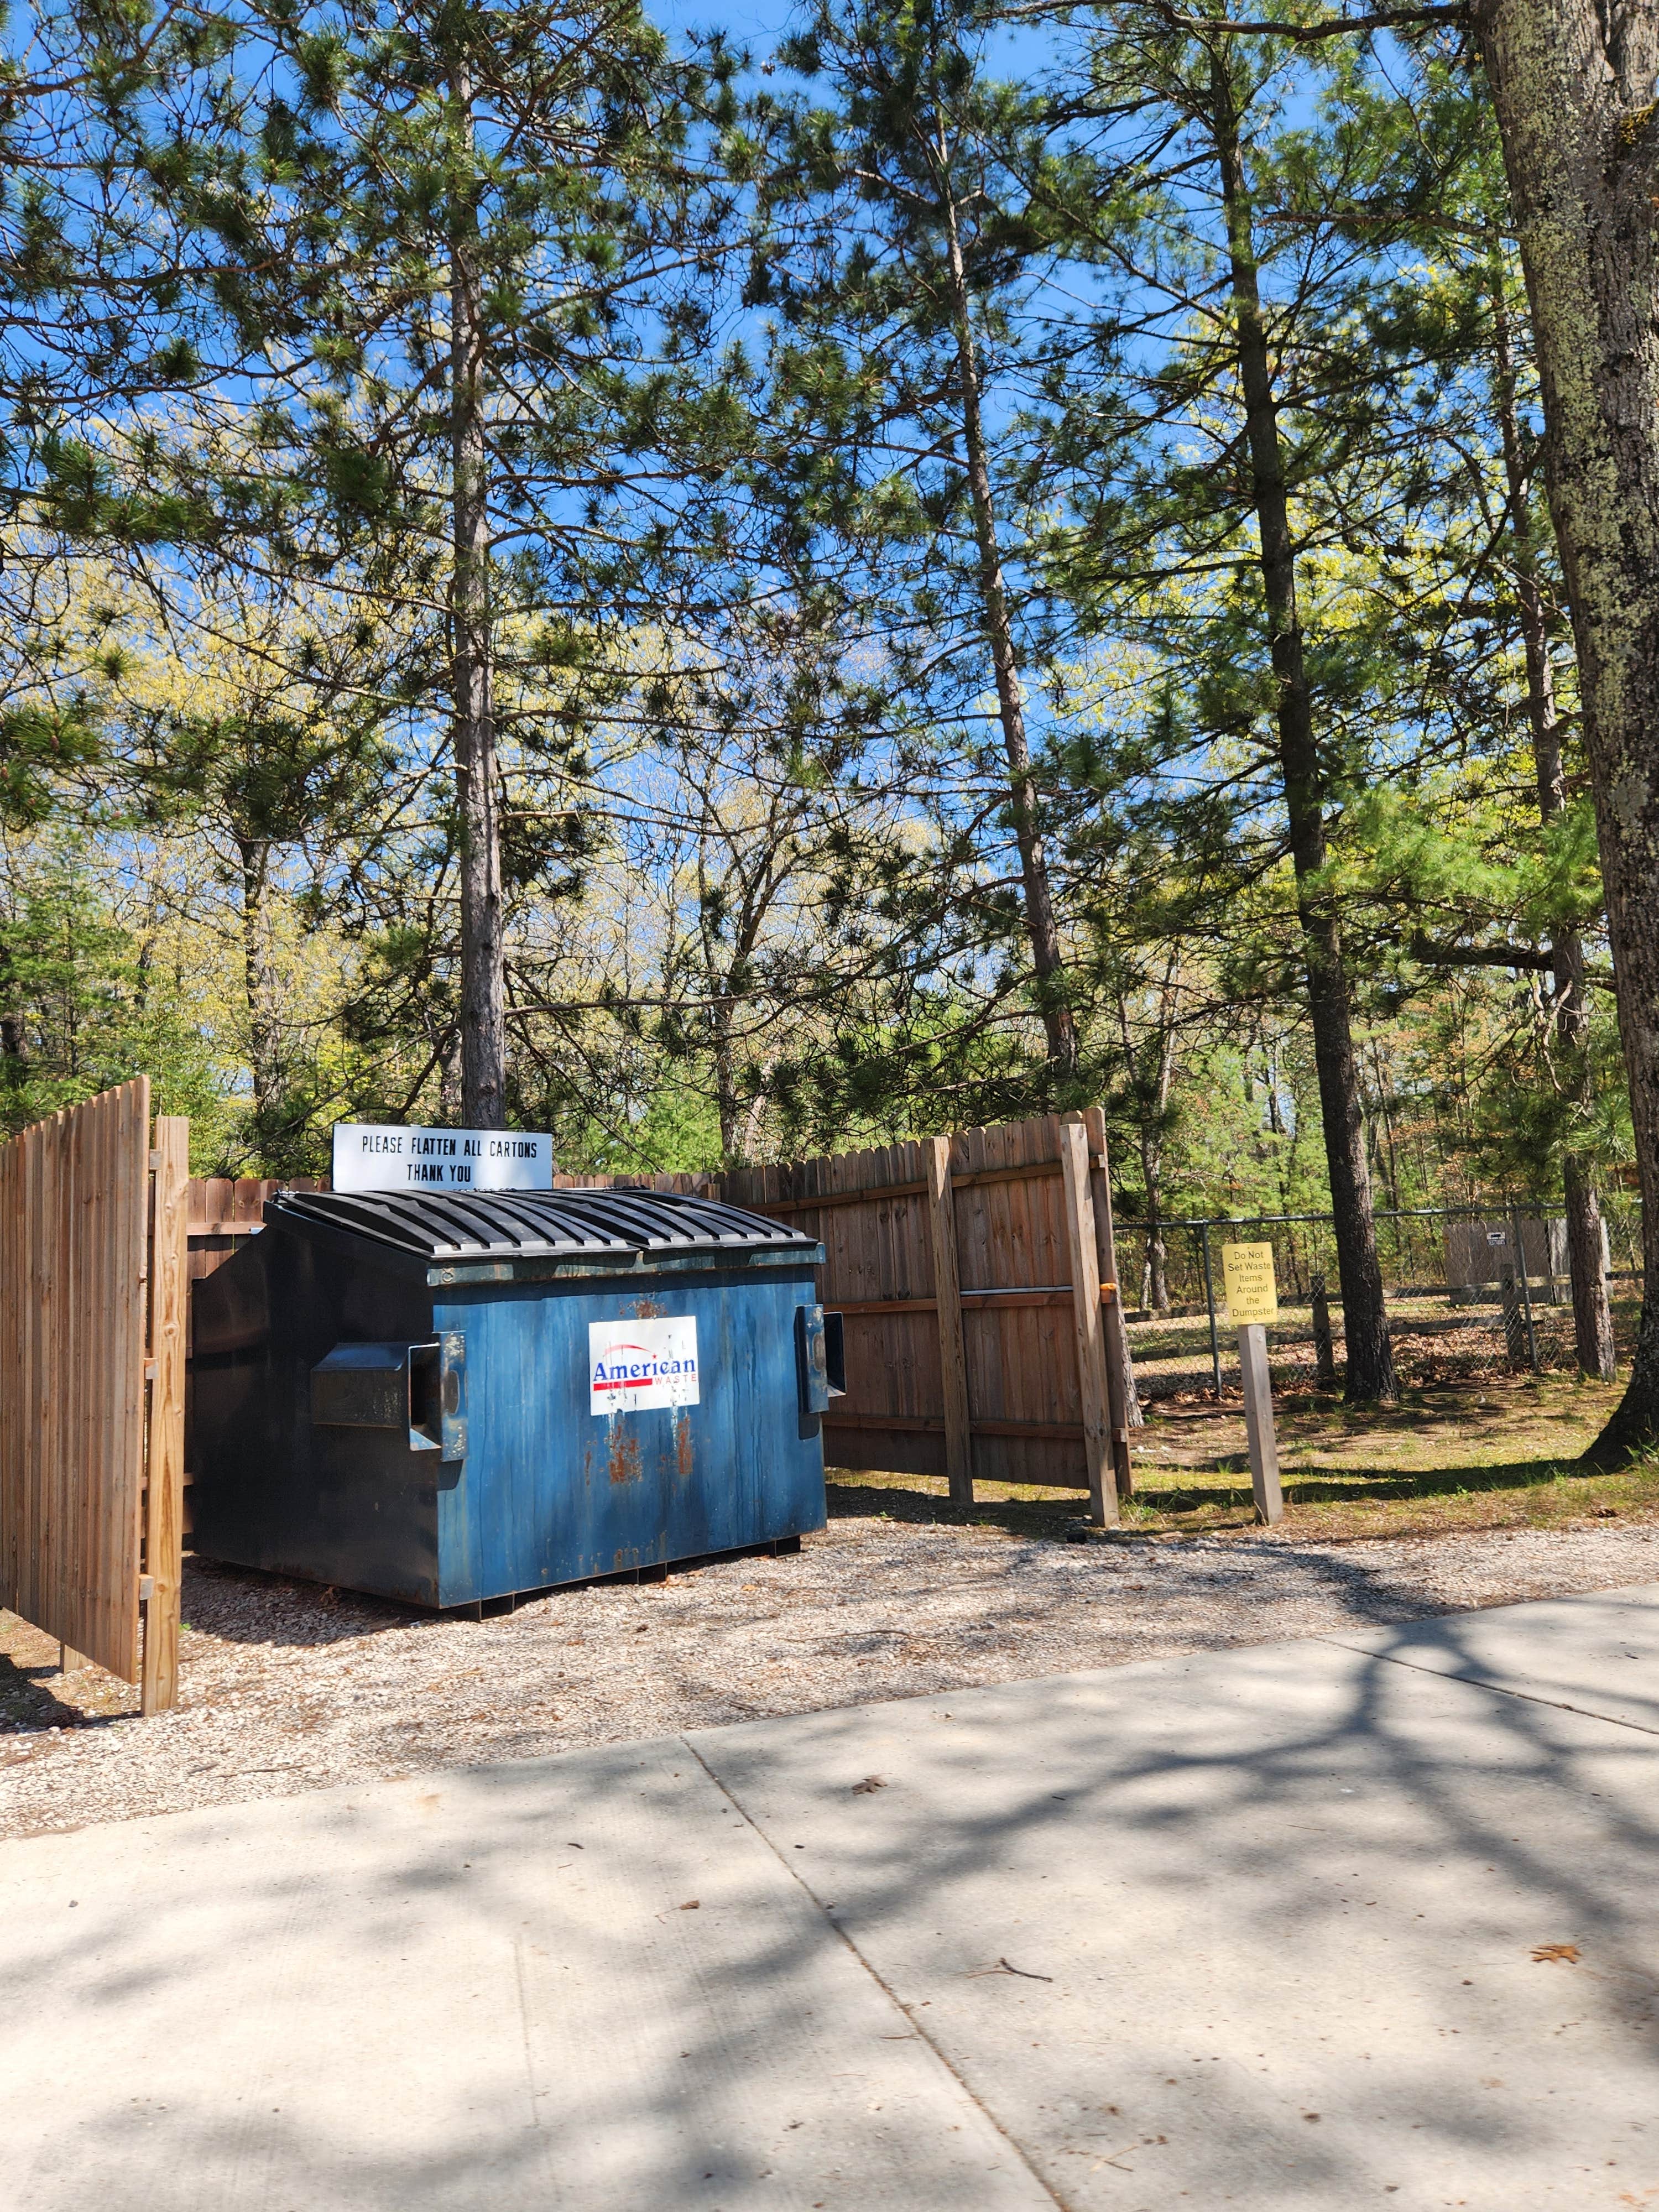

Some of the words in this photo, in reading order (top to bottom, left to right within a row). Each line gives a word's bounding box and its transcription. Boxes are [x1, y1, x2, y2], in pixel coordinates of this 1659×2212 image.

[362, 1135, 403, 1154] PLEASE
[411, 1138, 456, 1156] FLATTEN
[463, 1139, 482, 1157] ALL
[490, 1141, 537, 1159] CARTONS
[408, 1164, 443, 1182] THANK
[450, 1165, 471, 1182] YOU
[1234, 1251, 1245, 1260] Do
[1228, 1263, 1243, 1271] Set
[1244, 1262, 1271, 1270] Waste
[1237, 1284, 1268, 1293] Around
[1246, 1296, 1259, 1305] the
[1232, 1308, 1274, 1318] Dumpster
[593, 1358, 696, 1381] American
[655, 1374, 697, 1385] WASTE
